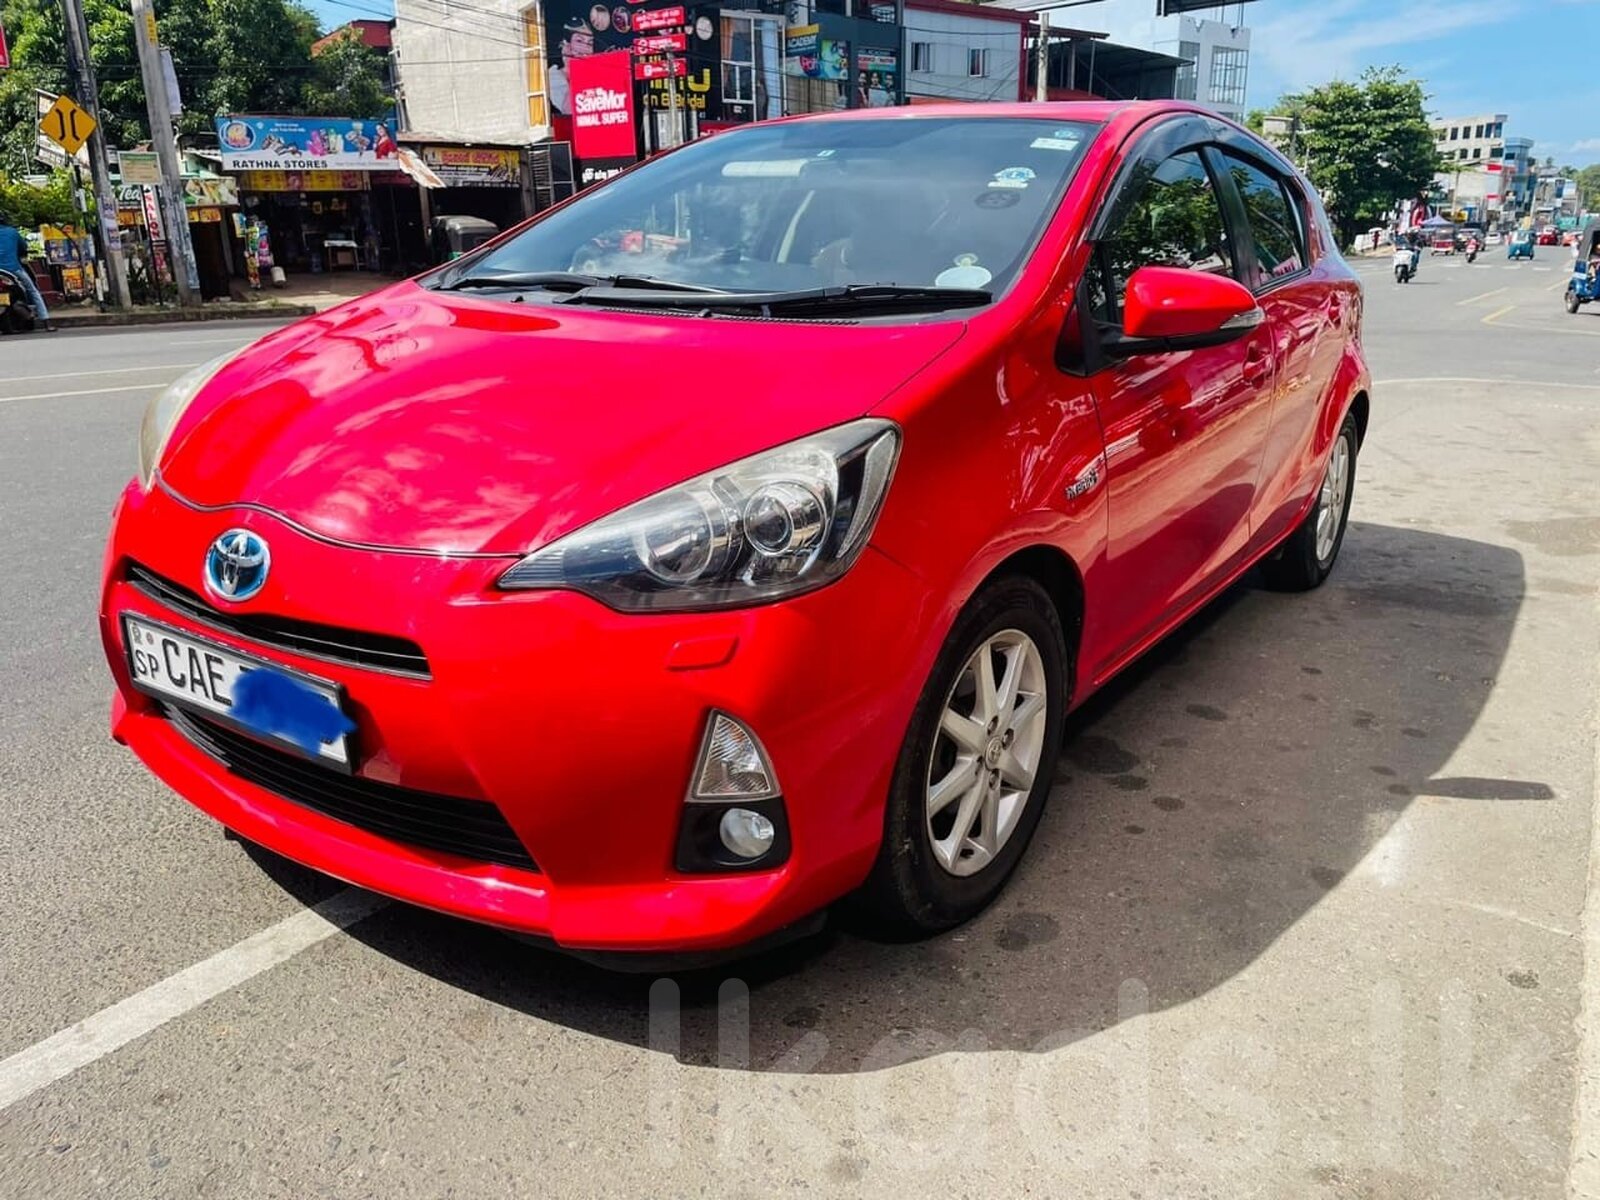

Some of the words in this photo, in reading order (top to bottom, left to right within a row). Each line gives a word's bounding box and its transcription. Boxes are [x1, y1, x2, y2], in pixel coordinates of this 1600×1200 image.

[232, 160, 281, 169] RATHNA
[284, 160, 328, 169] STORES
[135, 649, 159, 679] SP
[161, 638, 232, 707] CAE
